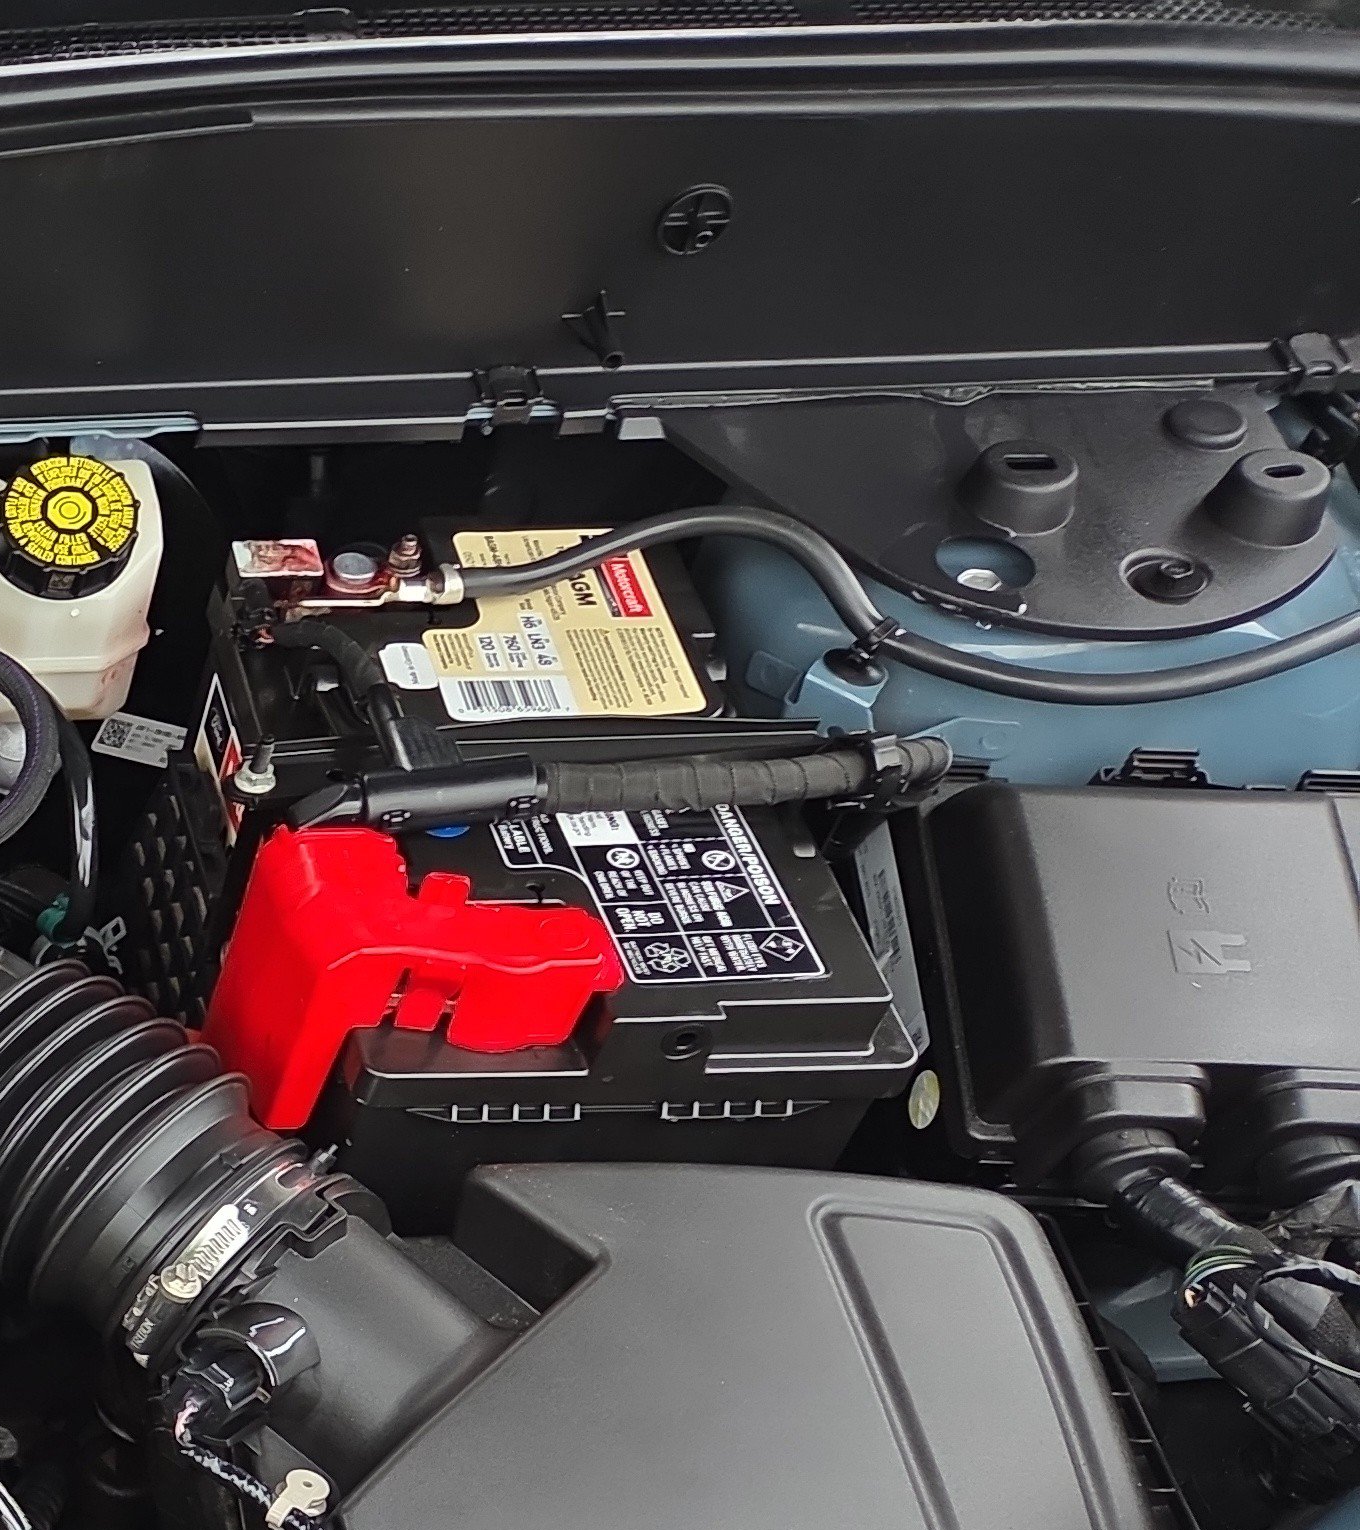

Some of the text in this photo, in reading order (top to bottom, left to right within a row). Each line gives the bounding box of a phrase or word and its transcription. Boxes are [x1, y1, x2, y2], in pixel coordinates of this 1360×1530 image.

[32, 520, 58, 541] CLEAN
[57, 532, 89, 544] FILLER
[611, 562, 648, 614] Motorcraft
[478, 637, 495, 651] 120
[503, 635, 521, 651] 760
[527, 633, 546, 650] LN3
[716, 803, 782, 906] DANGER/POISON
[615, 907, 638, 932] OPEN.
[631, 911, 652, 928] NOT
[647, 911, 665, 926] DO
